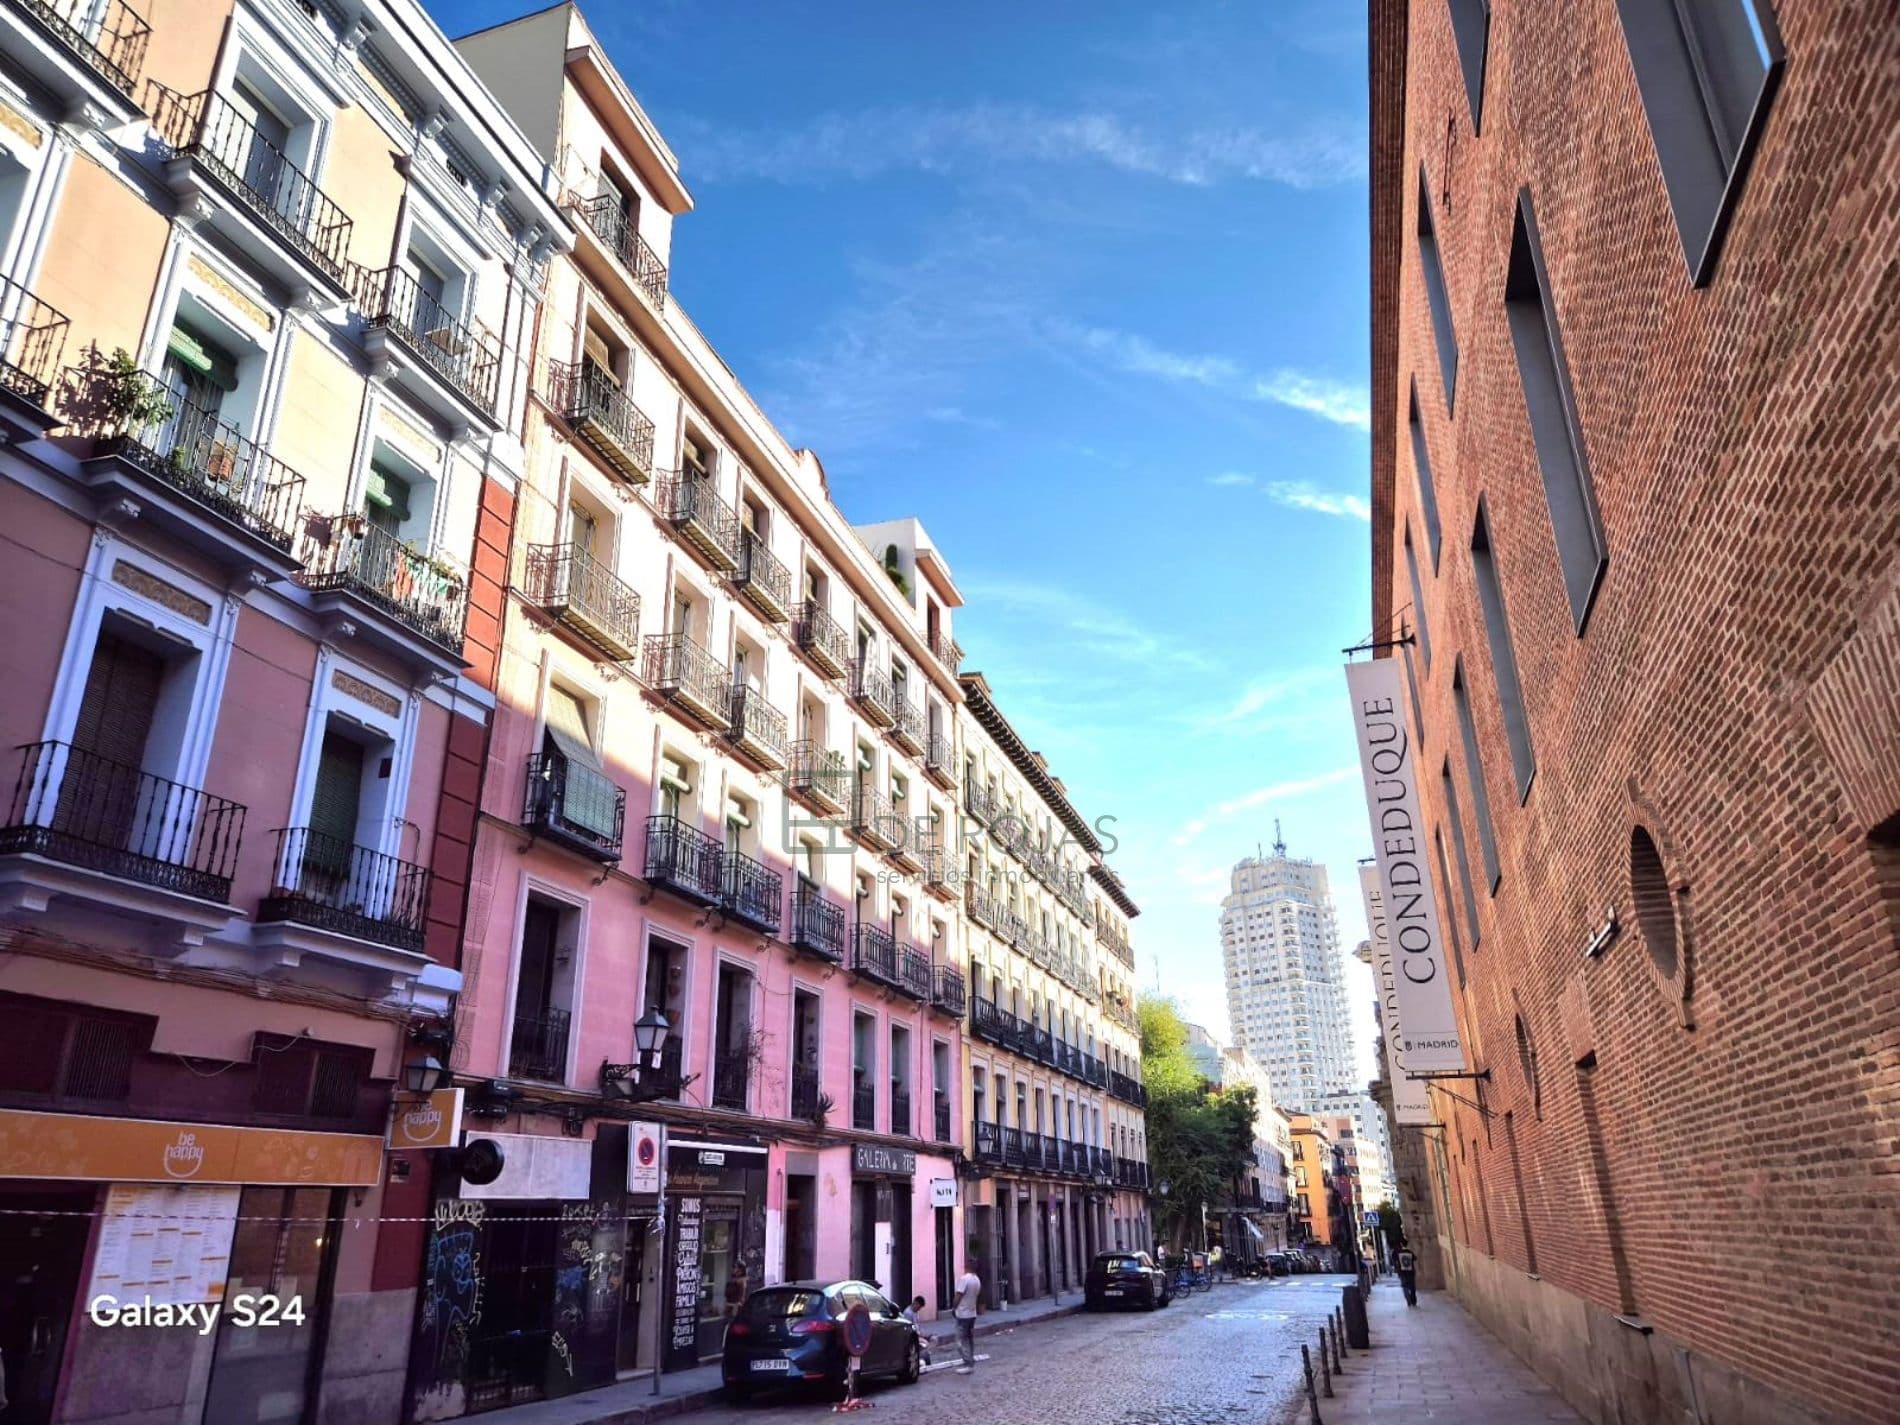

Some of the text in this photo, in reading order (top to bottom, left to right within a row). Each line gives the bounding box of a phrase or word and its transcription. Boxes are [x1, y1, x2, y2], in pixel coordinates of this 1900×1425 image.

[1363, 696, 1437, 984] CONDEDUQUE
[1417, 1039, 1460, 1049] MADRID
[165, 1144, 204, 1162] happy
